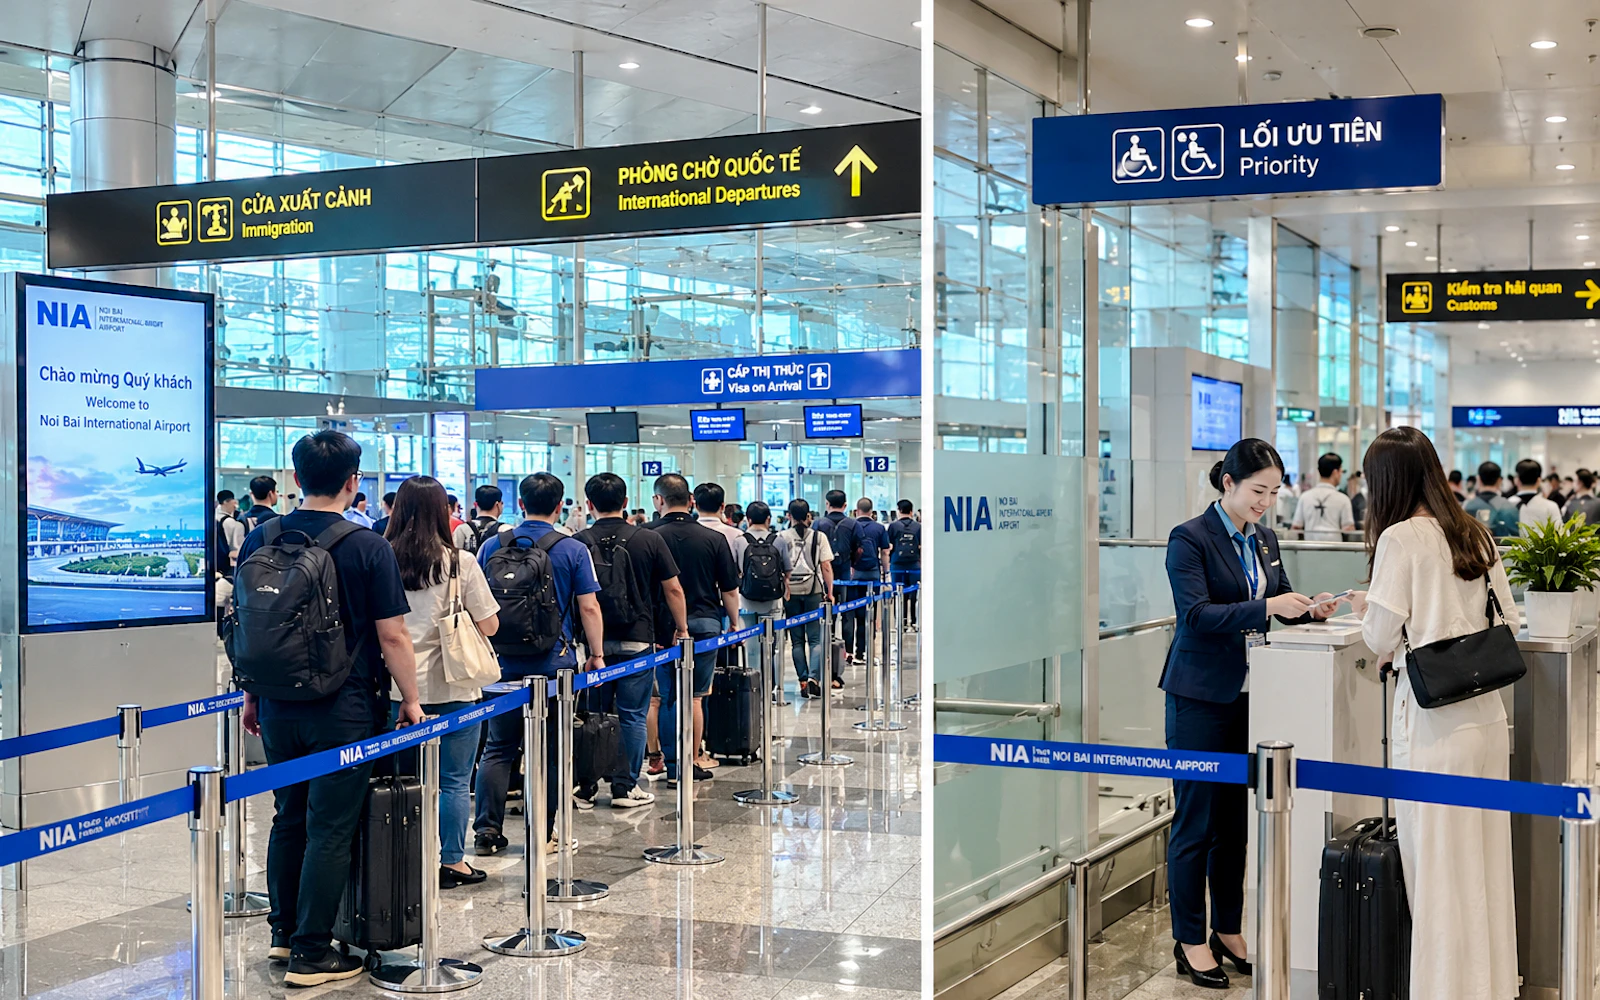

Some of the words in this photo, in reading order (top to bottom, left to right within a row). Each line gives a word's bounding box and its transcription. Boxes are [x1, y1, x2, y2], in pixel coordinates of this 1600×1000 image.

[1240, 119, 1278, 148] LỐI
[1287, 123, 1322, 146] ƯU
[618, 160, 678, 185] PHÒNG
[682, 155, 721, 181] CHỜ
[724, 149, 775, 178] QUỐC
[779, 146, 802, 172] TẾ
[1240, 154, 1319, 178] Priority
[241, 192, 276, 215] CỬA
[280, 187, 321, 213] XUẤT
[325, 185, 371, 209] CẢNH
[618, 187, 711, 211] International
[716, 183, 801, 206] Departures
[242, 218, 314, 239] Immigration
[1483, 282, 1502, 295] tra
[1529, 283, 1562, 297] quan
[37, 300, 92, 329] NIA
[1447, 299, 1498, 311] Customs
[39, 366, 76, 383] Chào
[80, 368, 119, 388] mừng
[123, 371, 150, 390] Quý
[154, 373, 193, 389] khách
[728, 382, 750, 393] Visa
[752, 384, 765, 392] on
[768, 379, 802, 392] Arrival
[85, 396, 136, 410] Welcome
[138, 399, 150, 411] to
[40, 415, 59, 427] Noi
[63, 415, 80, 428] Bai
[83, 416, 151, 431] International
[154, 420, 191, 434] Airport
[944, 496, 993, 532] NIA
[188, 702, 206, 716] NIA
[340, 746, 364, 766] NIA
[990, 743, 1030, 763] NIA
[1053, 750, 1071, 762] NOI
[1074, 752, 1090, 764] BAI
[1093, 753, 1173, 770] INTERNATIONAL
[40, 823, 77, 851] NIA
